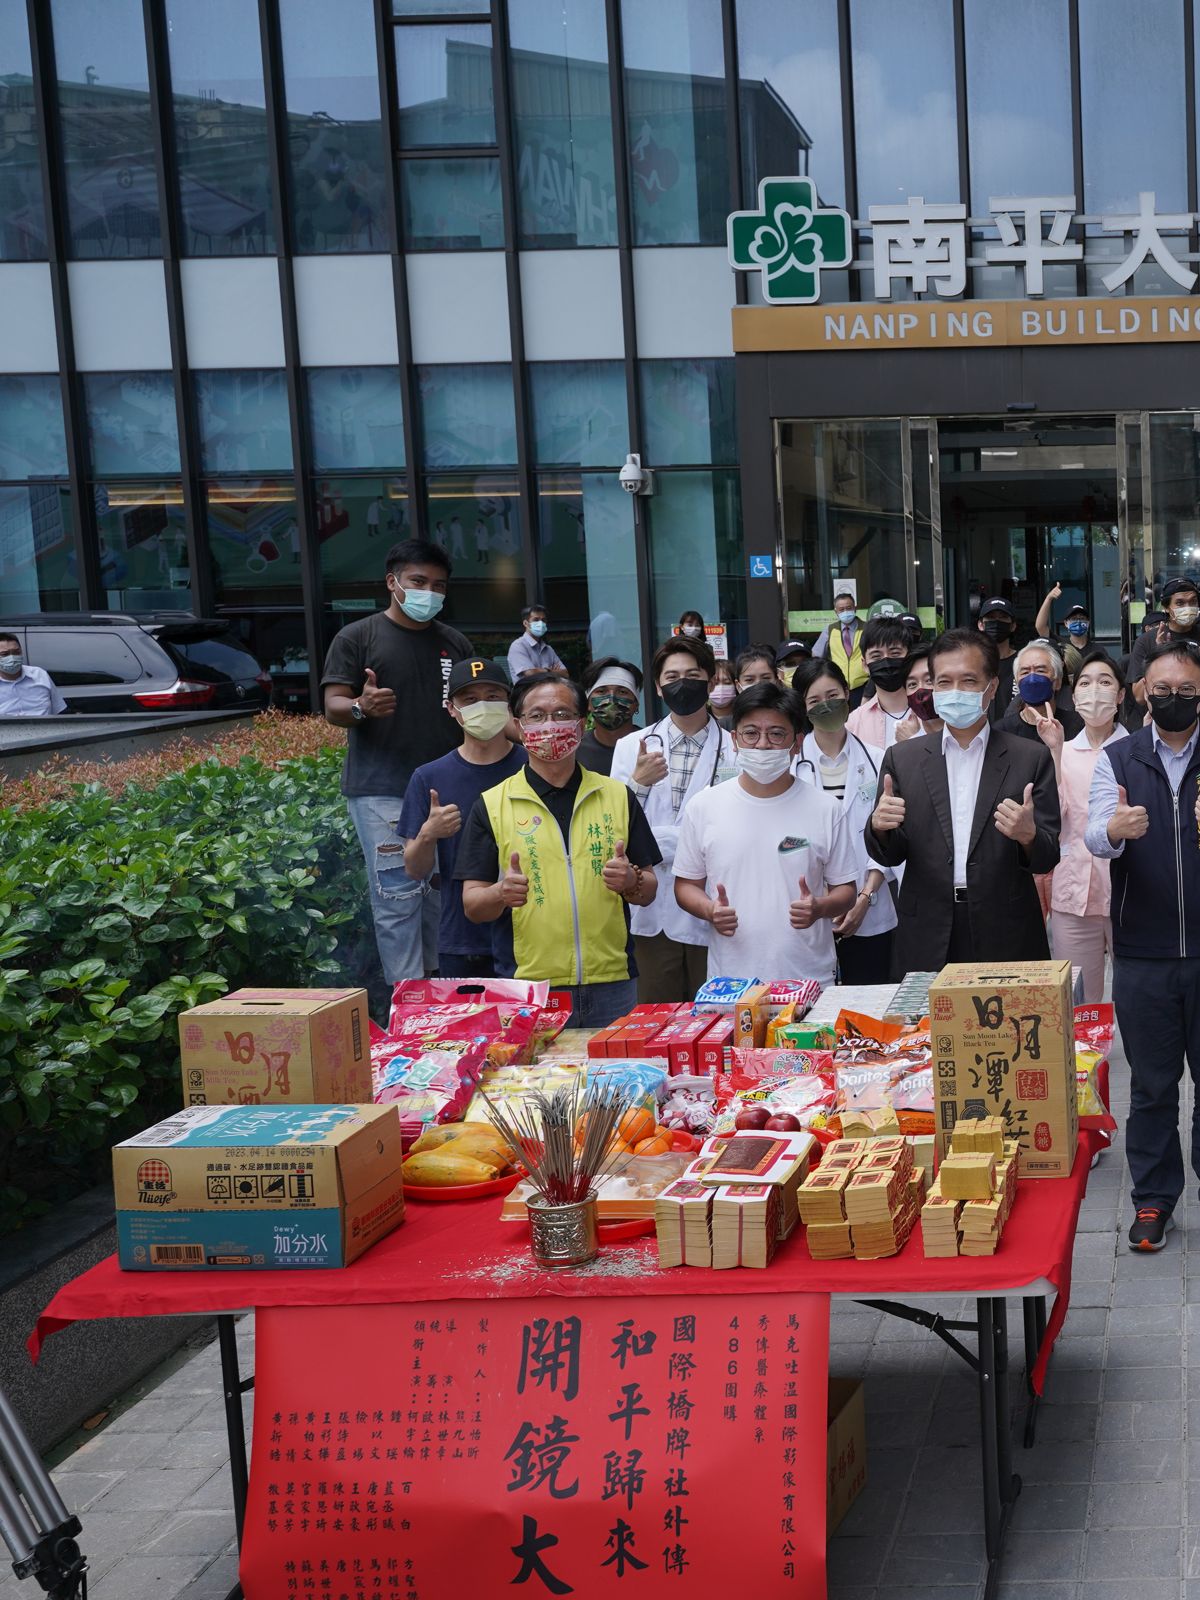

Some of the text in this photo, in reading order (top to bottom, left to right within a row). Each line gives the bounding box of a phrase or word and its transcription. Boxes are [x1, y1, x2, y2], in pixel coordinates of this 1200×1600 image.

[824, 312, 993, 341] NANPING
[471, 661, 484, 678] P
[587, 823, 604, 877] 林世賢
[838, 1070, 891, 1088] Doritos
[273, 1233, 328, 1254] 加分水
[753, 1314, 770, 1443] 秀傳醫療體系
[502, 1314, 583, 1596] 開鏡大
[601, 1319, 657, 1578] 和平歸來
[662, 1314, 697, 1576] 國際橋牌社外傳
[780, 1313, 800, 1580] 馬克吐溫國際影像有限公司
